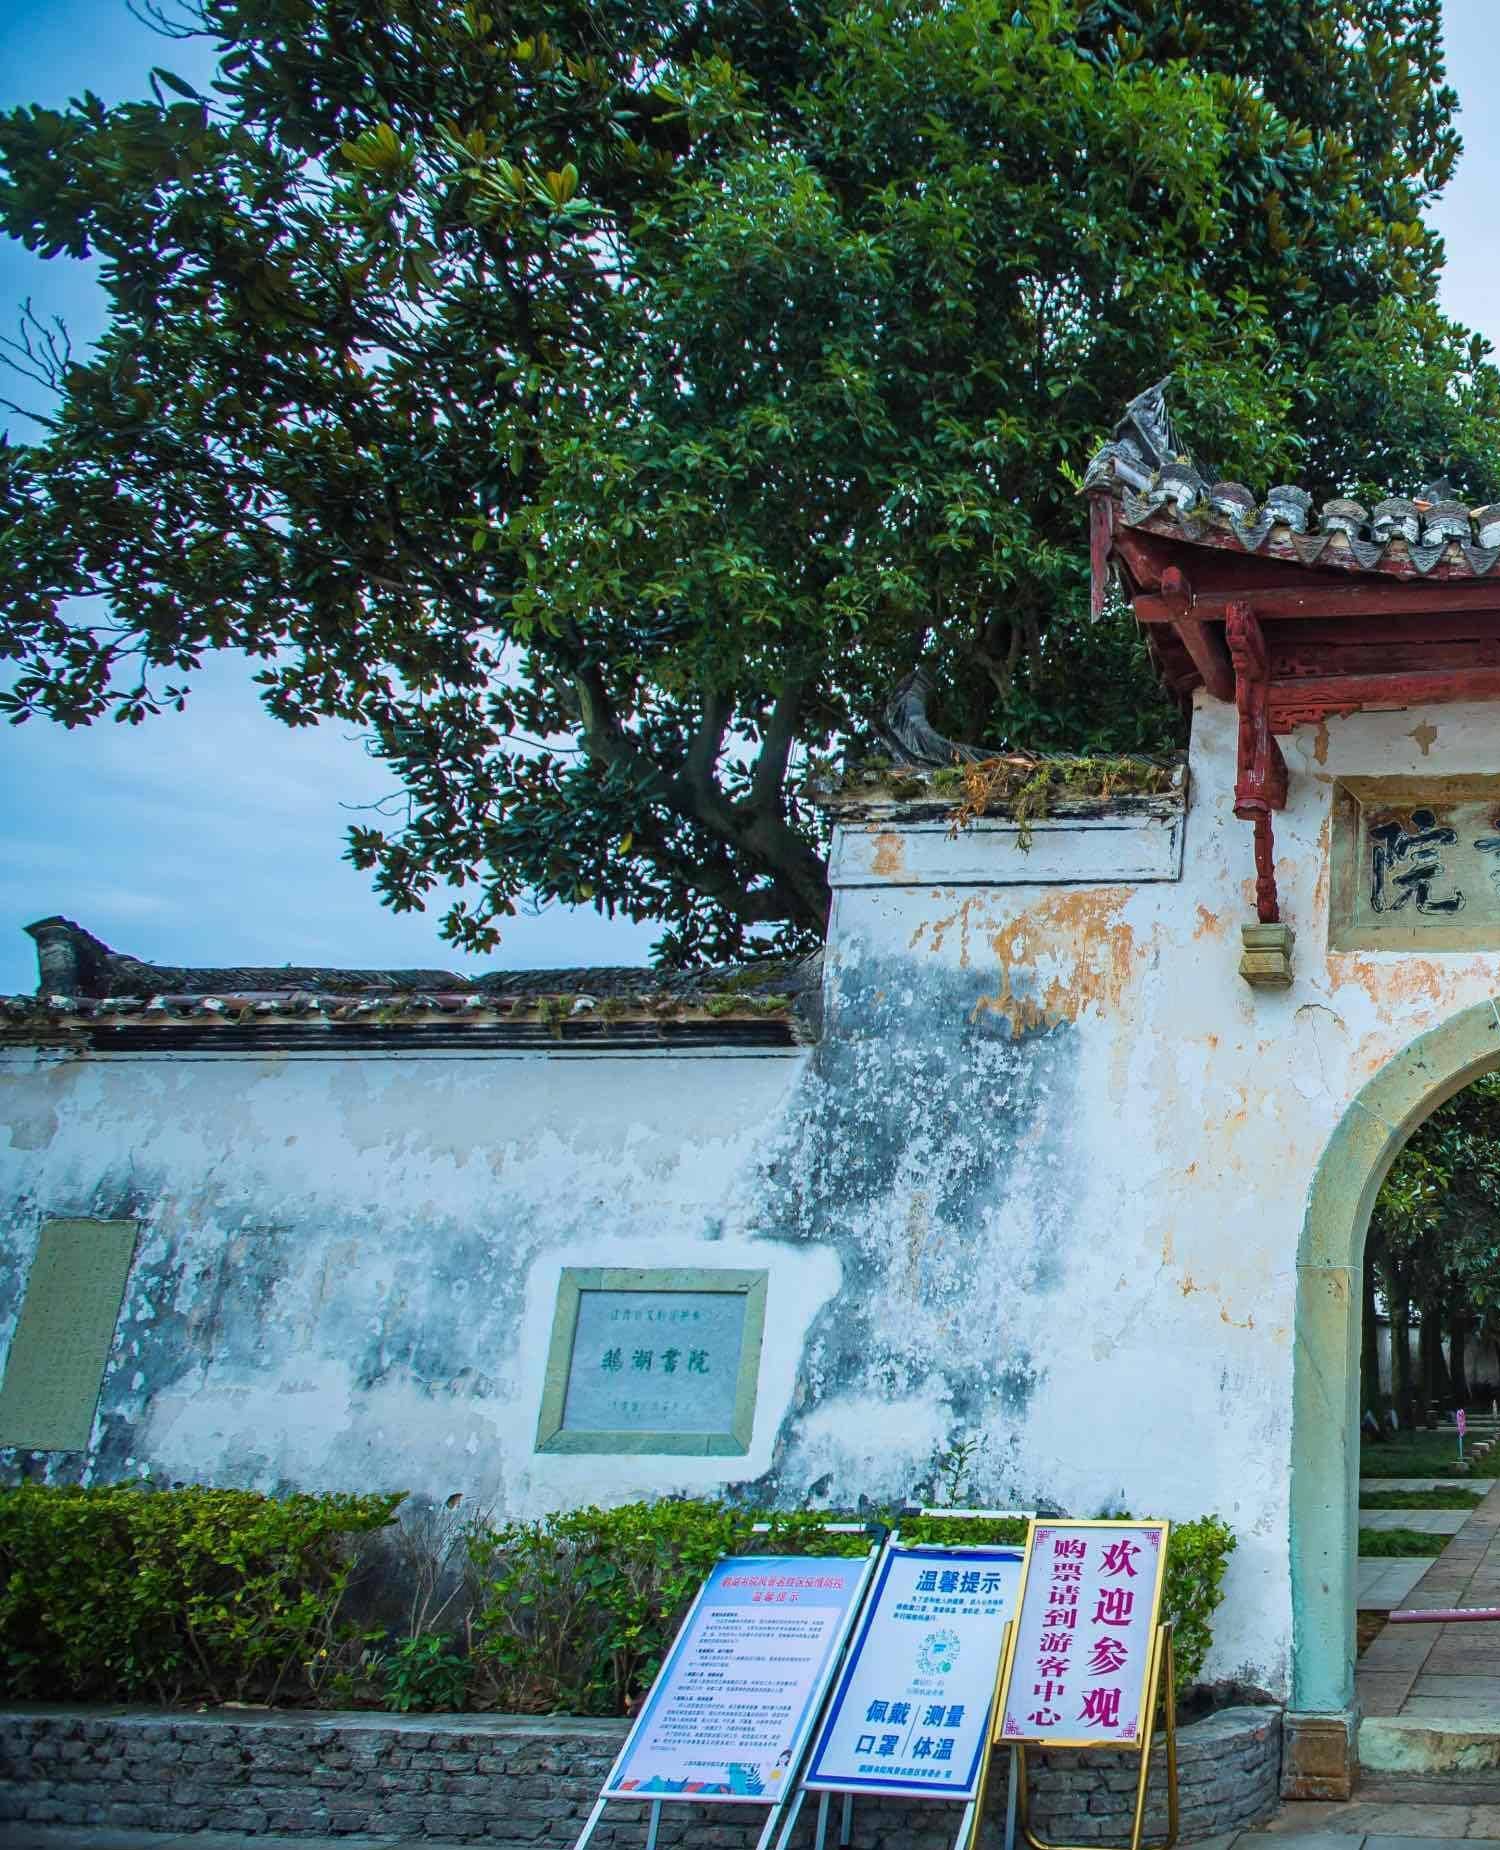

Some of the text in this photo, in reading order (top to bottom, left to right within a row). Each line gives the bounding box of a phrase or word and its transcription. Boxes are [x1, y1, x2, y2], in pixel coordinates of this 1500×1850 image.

[915, 1570, 1001, 1594] 温馨提示
[1027, 1539, 1088, 1726] 购票请到游客中心
[1075, 1539, 1142, 1728] 欢迎参观
[865, 1700, 965, 1728] 佩戴 测量
[855, 1734, 955, 1760] 口罩 体温
